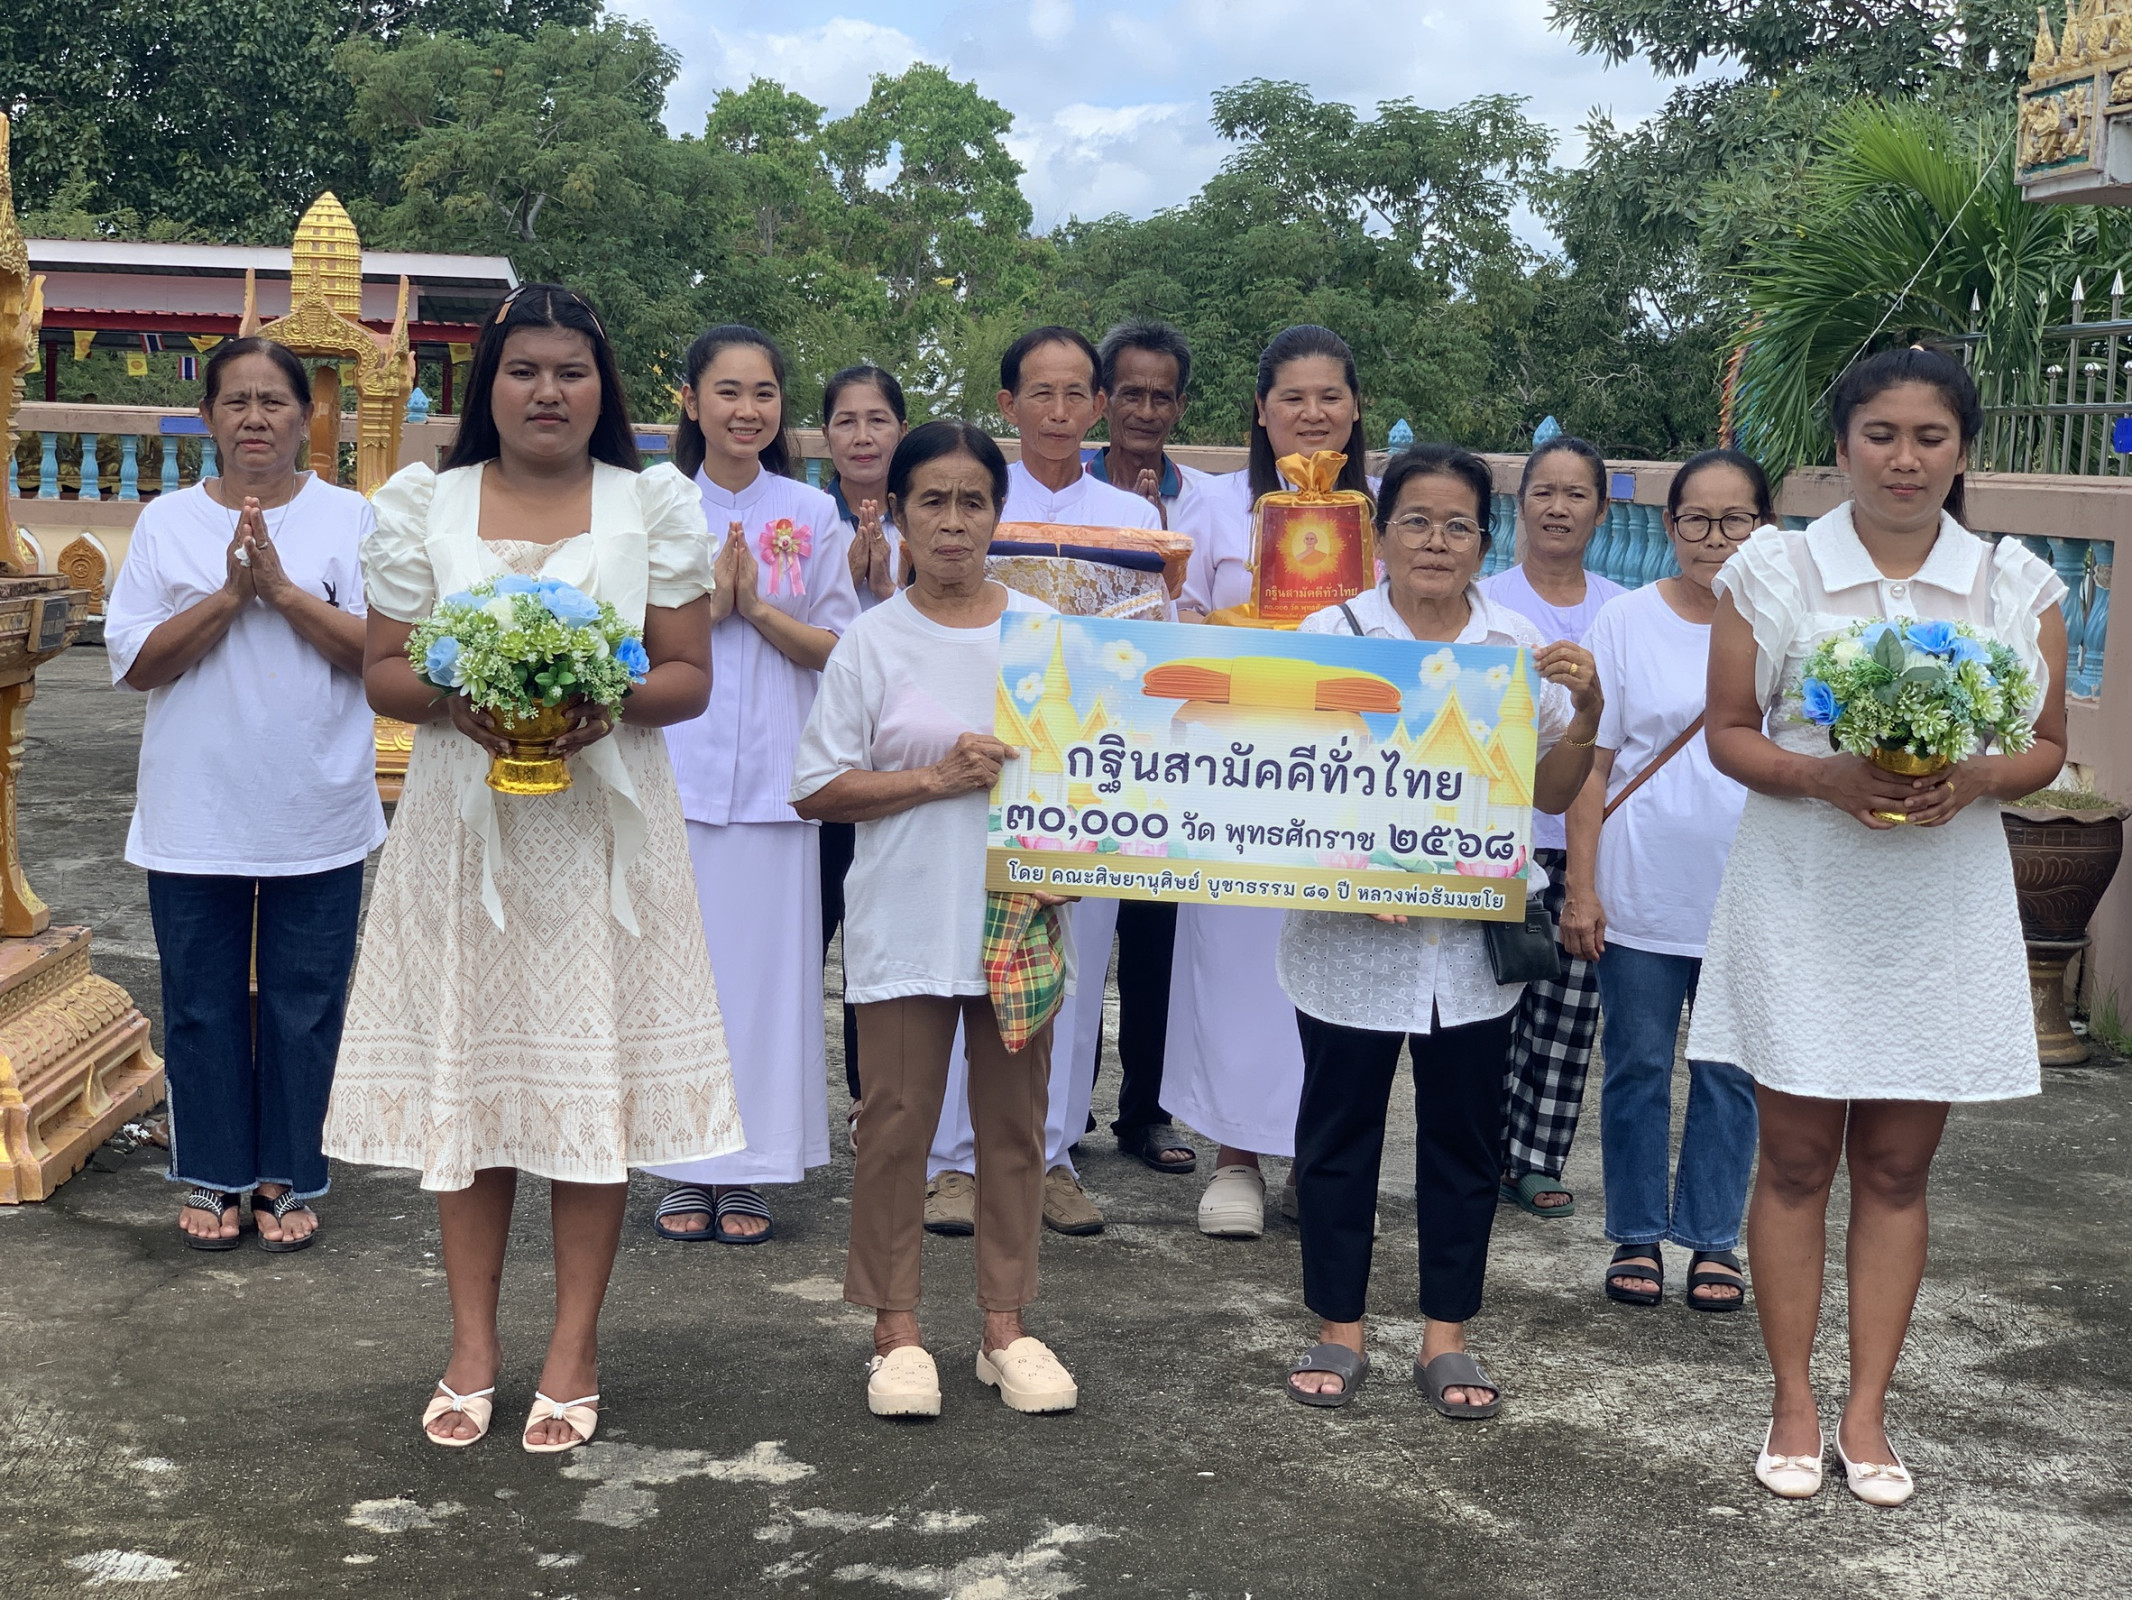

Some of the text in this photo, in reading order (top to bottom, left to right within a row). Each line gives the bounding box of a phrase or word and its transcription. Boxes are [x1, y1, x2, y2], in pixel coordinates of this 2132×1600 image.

[1265, 582, 1358, 600] กฐินสามัคคีทั่วไทย
[1068, 733, 1463, 801] กฐินสามัคคีทั่วไทย
[1006, 804, 1515, 860] ๓๐,๐๐๐ วัด พุทธศักราช ๒๕๖๘
[1009, 860, 1504, 909] โดย คณะศิษยานุศิษย์ บูชาธรรม ๘๑ ปี หลวงพ่อธัมมชโย
